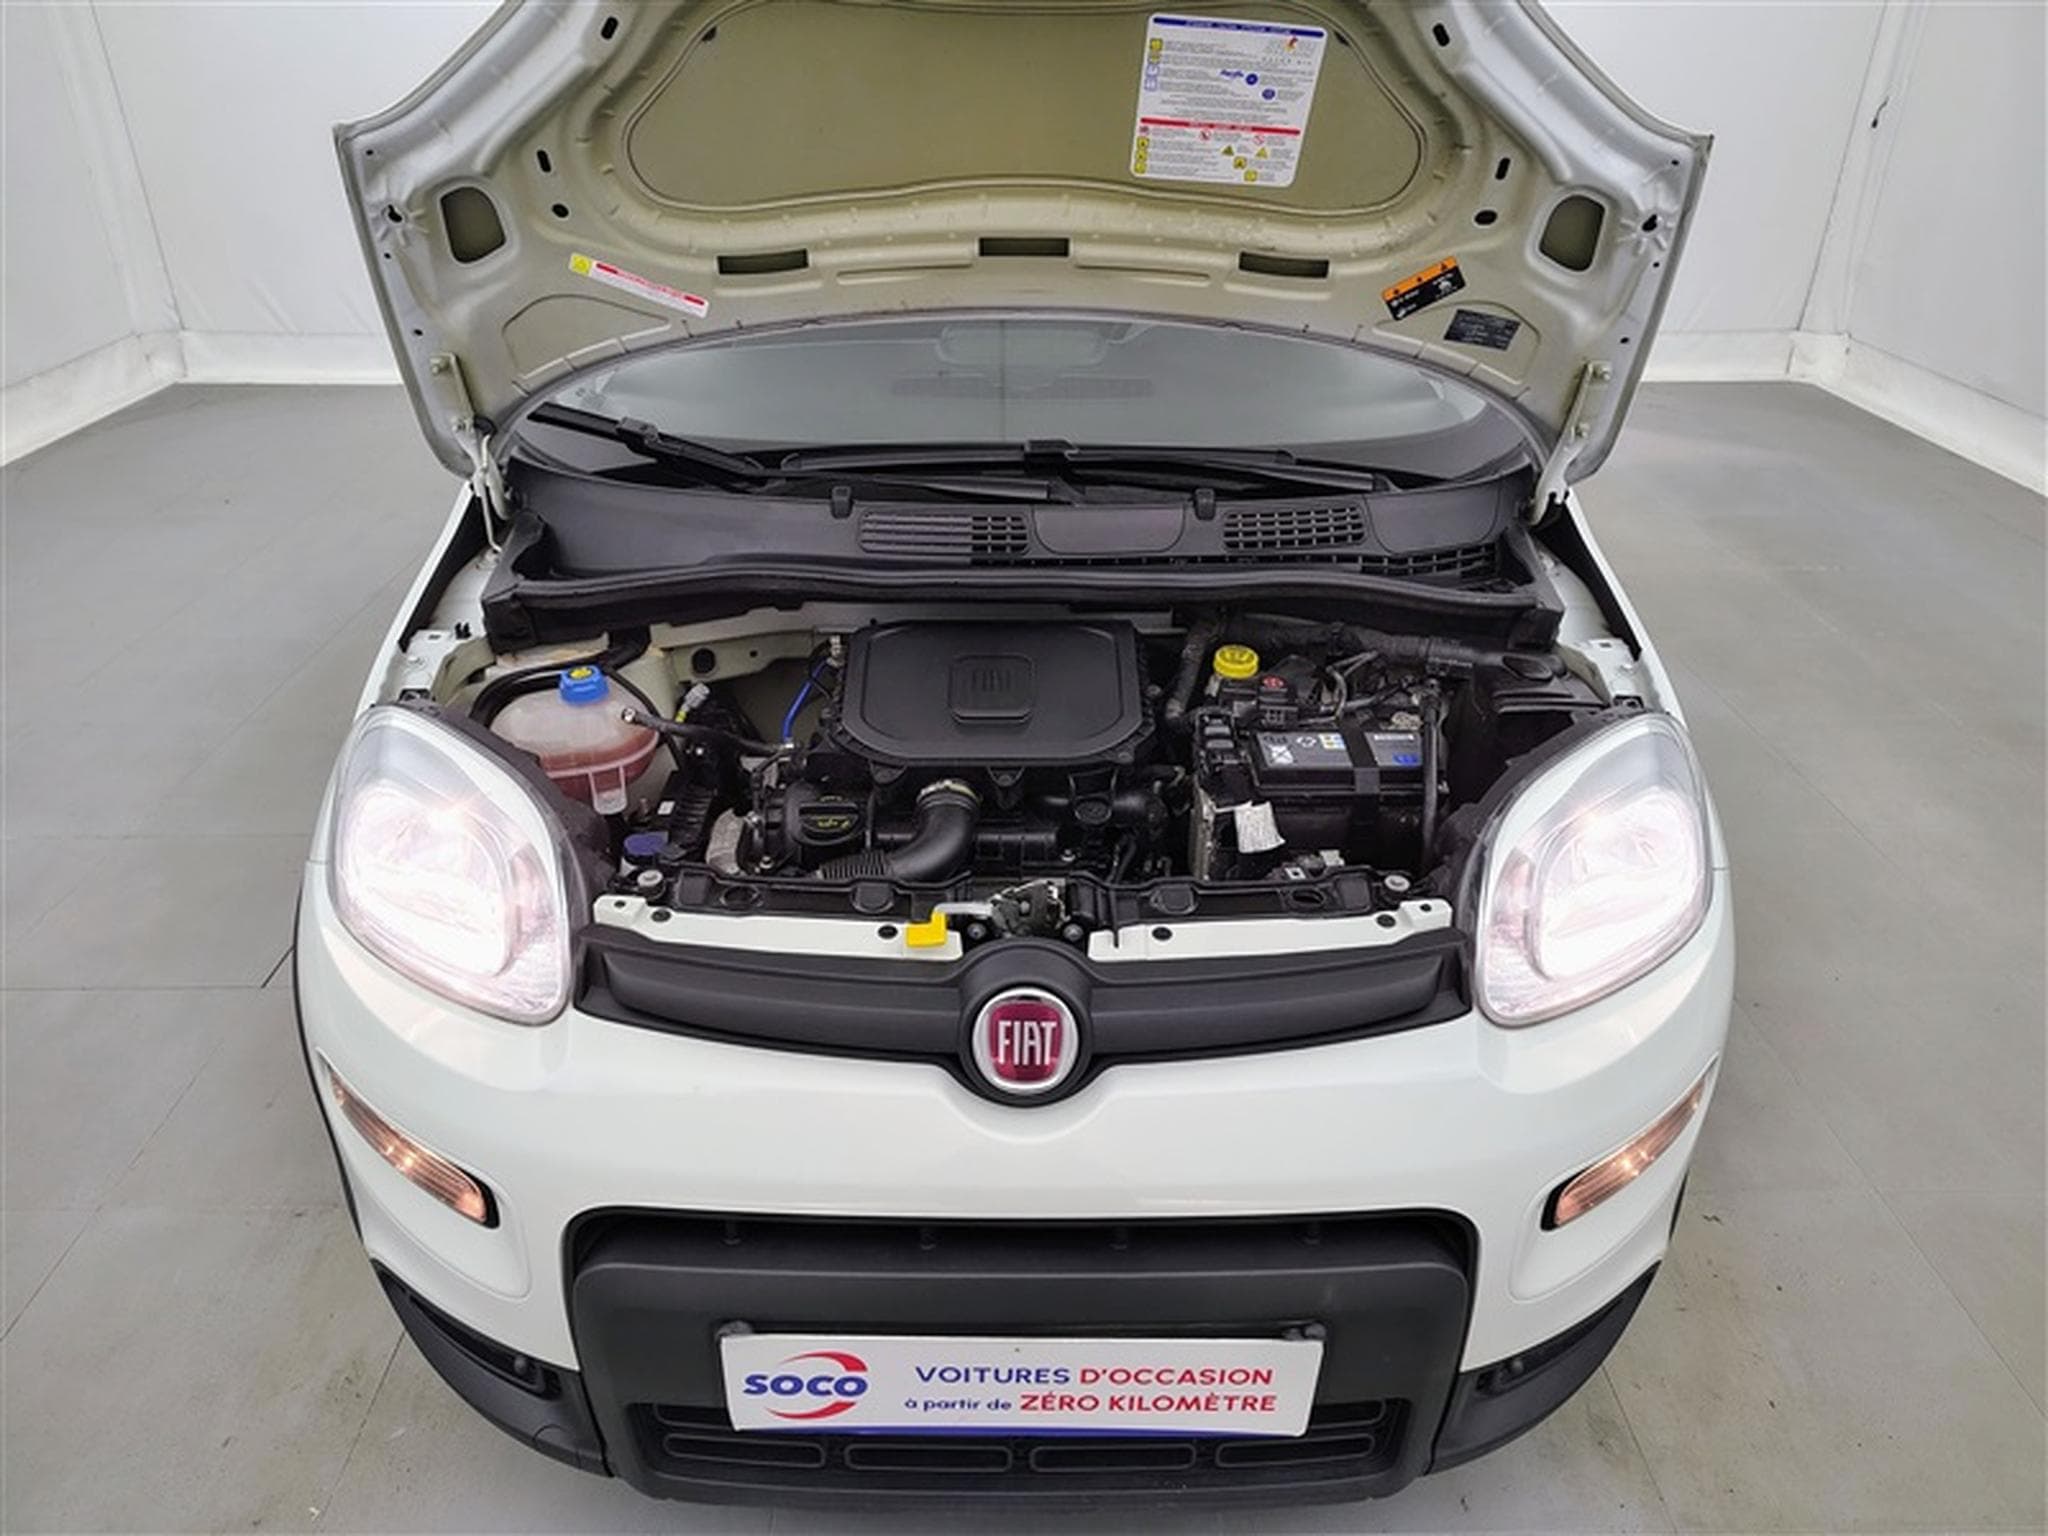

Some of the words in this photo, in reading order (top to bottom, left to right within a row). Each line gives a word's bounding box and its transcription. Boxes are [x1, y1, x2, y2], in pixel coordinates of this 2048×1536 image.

[998, 1020, 1057, 1066] FIAT
[743, 1374, 868, 1396] SOCO
[915, 1366, 1070, 1384] VOITURES
[1079, 1367, 1273, 1385] D'OCCASION
[904, 1397, 917, 1410] à
[923, 1398, 981, 1412] partir
[986, 1398, 1012, 1410] de
[1020, 1391, 1100, 1411] ZÉRO
[1108, 1391, 1277, 1412] KILOMÈTRE
